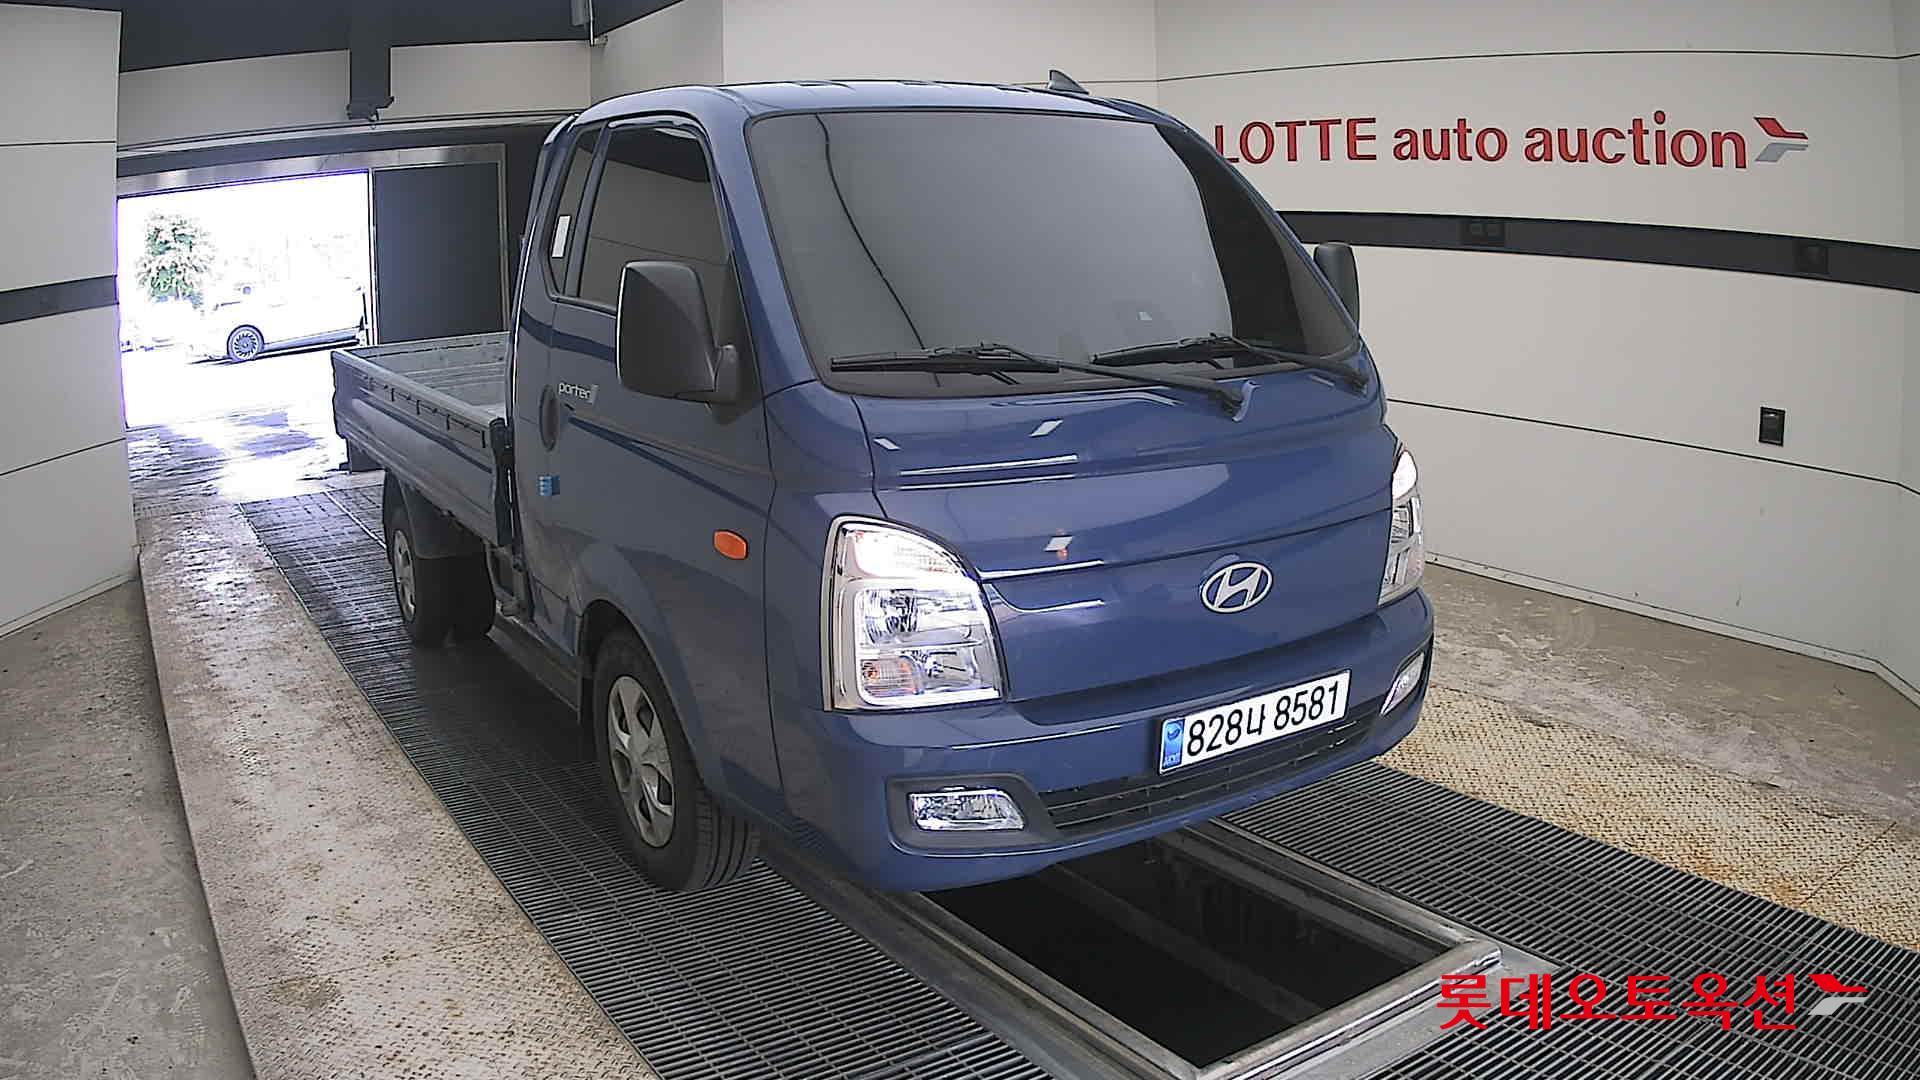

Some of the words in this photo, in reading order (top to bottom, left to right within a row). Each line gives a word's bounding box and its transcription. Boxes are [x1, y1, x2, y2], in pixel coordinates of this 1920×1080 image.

[1214, 117, 1378, 165] LOTTE
[1393, 118, 1509, 162] auto
[1523, 111, 1747, 169] auction
[1187, 703, 1266, 757] 828나
[1273, 680, 1339, 731] 8581
